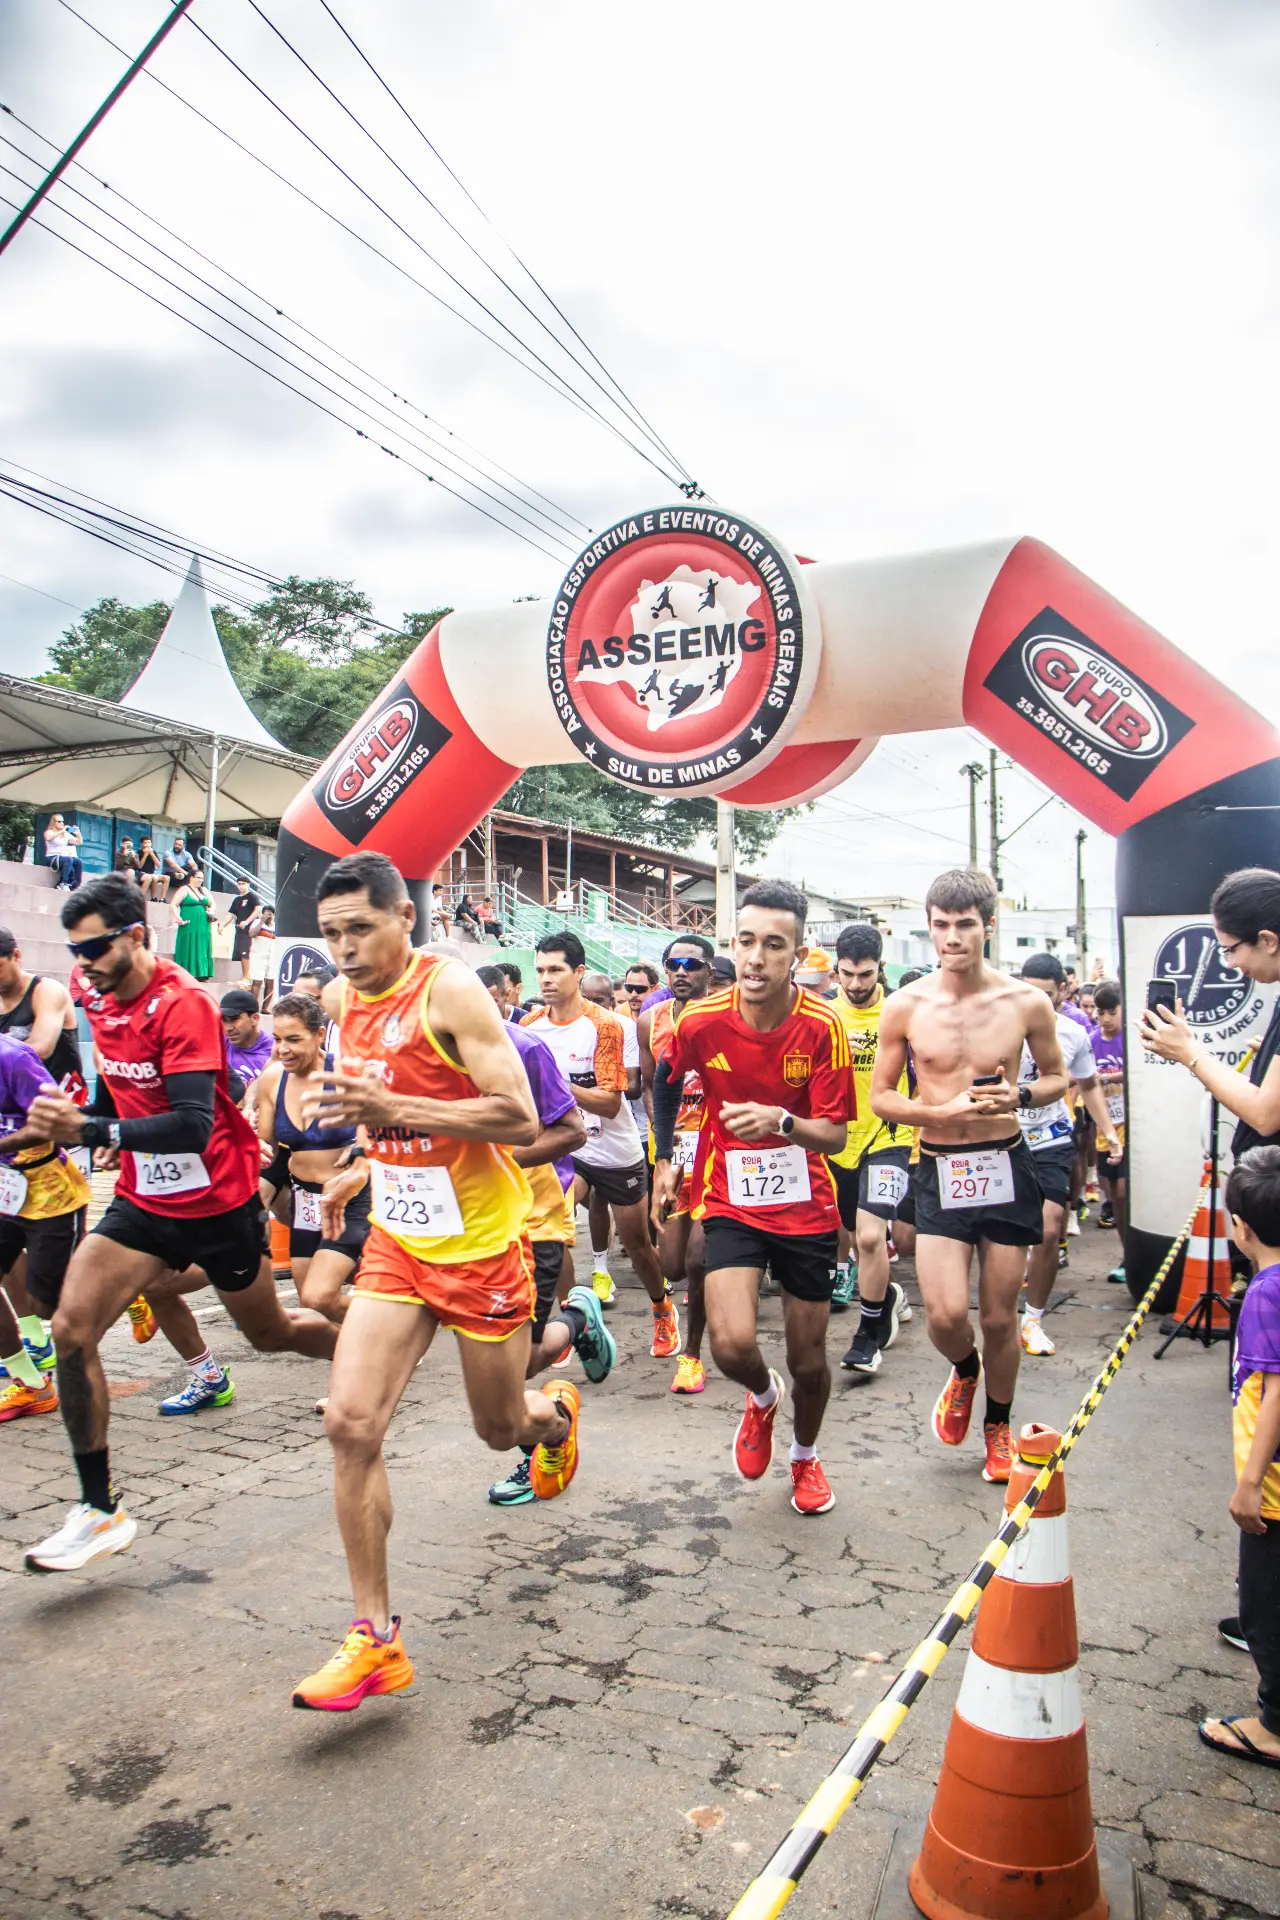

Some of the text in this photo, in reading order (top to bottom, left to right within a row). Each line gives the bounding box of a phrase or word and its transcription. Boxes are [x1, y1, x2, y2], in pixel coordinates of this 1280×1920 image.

[549, 511, 796, 733] ASSOCIAÇÃO ESPORTIVA E EVENTOS DE MINAS GERAIS
[577, 618, 767, 671] ASSEEMG
[1087, 659, 1133, 698] GRUPO
[1032, 647, 1152, 750] GHB
[349, 725, 377, 760] GRUPO
[1016, 696, 1112, 775] 35.3851.2165
[335, 711, 412, 801] GHB
[607, 748, 742, 784] SUL DE MINAS
[365, 744, 430, 820] 35.3851.2165
[1185, 989, 1244, 1022] AFUSOS
[1216, 999, 1264, 1040] VAREJO
[143, 1162, 182, 1184] 243
[741, 1175, 786, 1197] 172
[878, 1182, 900, 1201] 211
[951, 1177, 990, 1199] 297
[385, 1196, 429, 1225] 223
